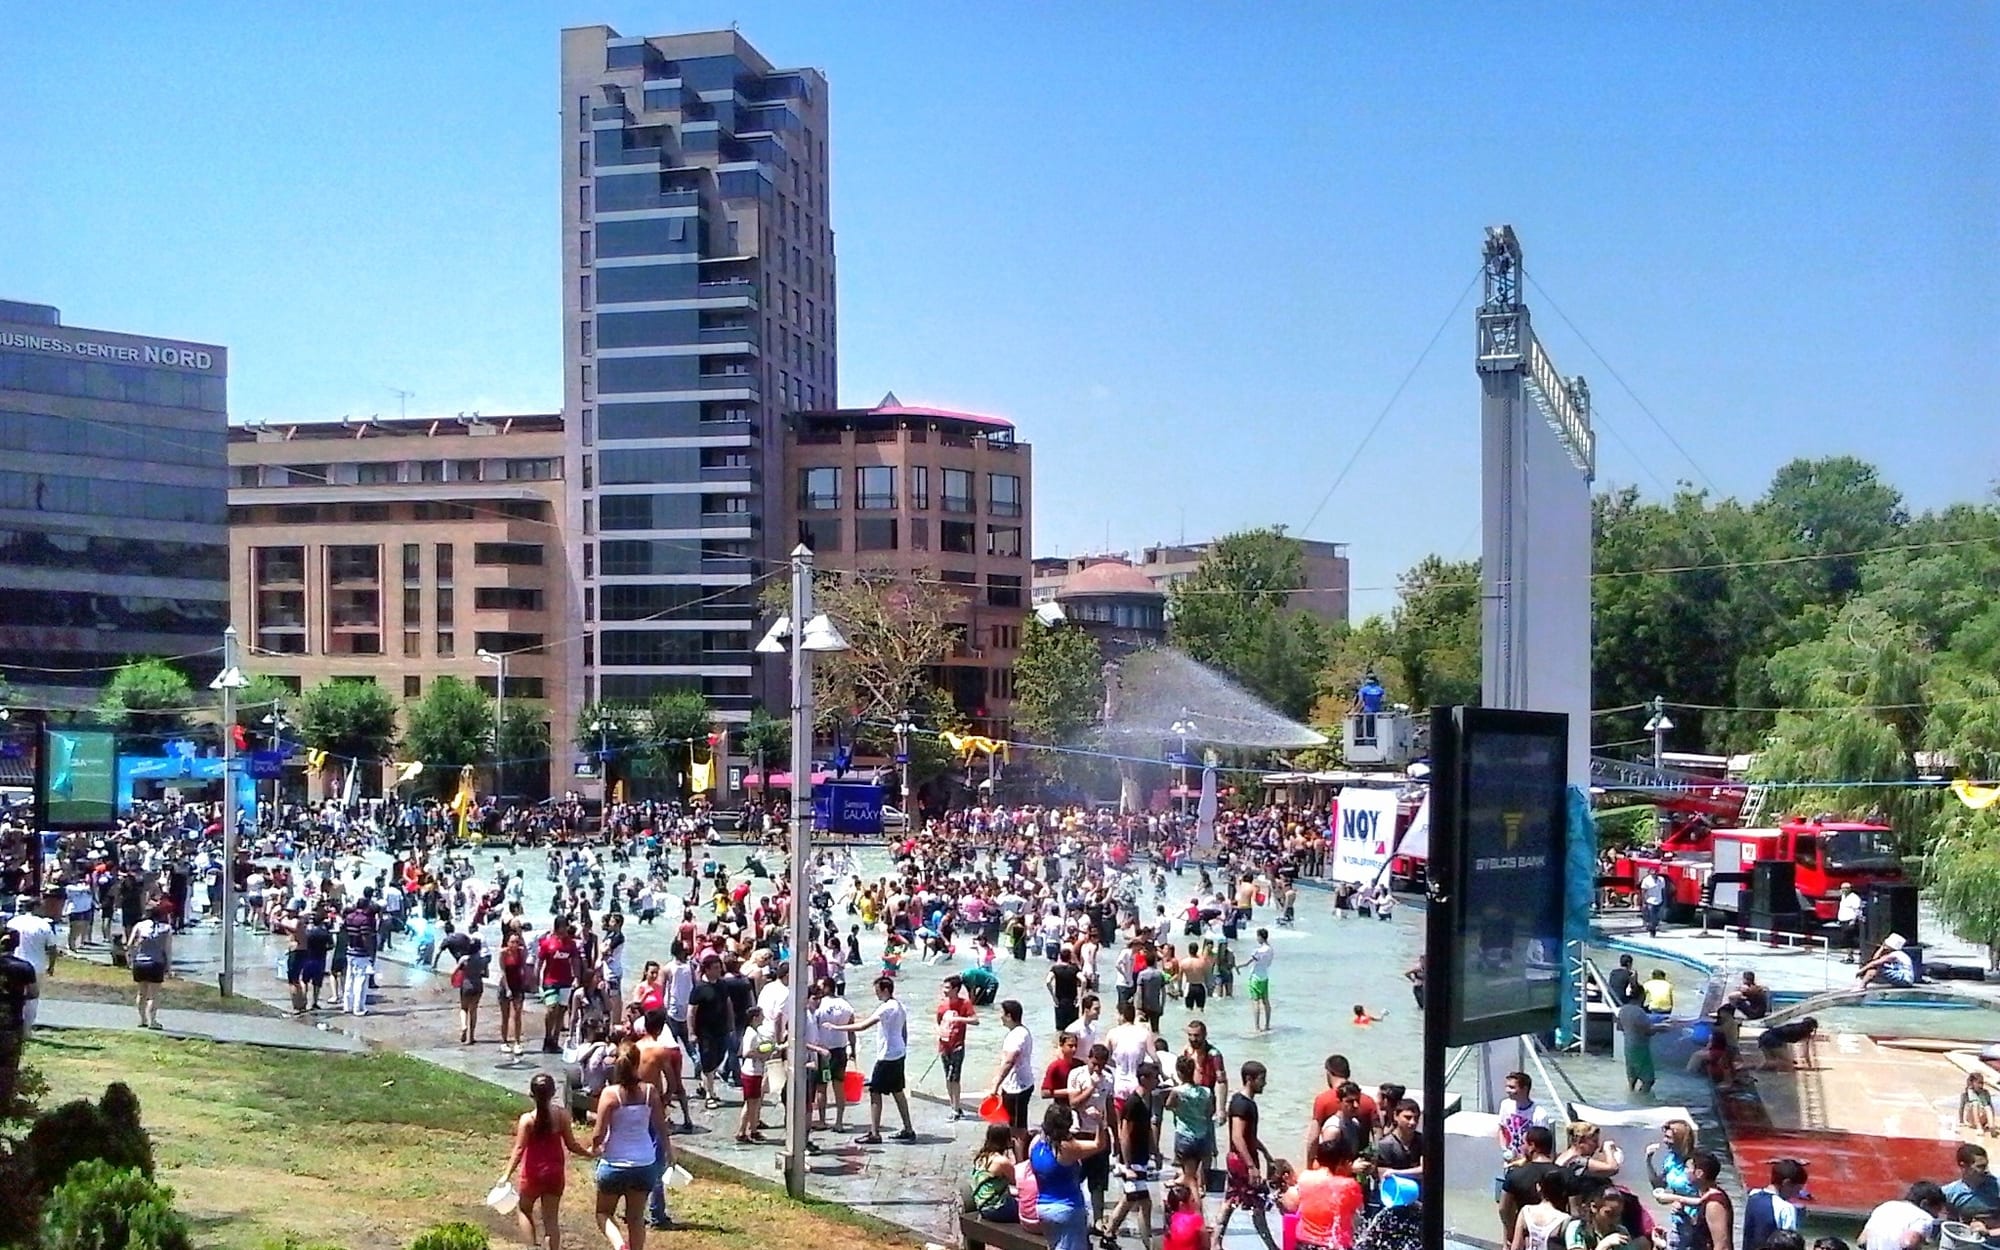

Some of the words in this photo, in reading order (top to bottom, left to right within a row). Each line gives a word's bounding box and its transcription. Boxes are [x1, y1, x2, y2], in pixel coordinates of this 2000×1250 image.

[0, 332, 72, 353] USINESS
[75, 341, 140, 362] CENTER
[144, 345, 213, 370] NORD
[844, 809, 880, 821] GALAXY
[1342, 808, 1381, 841] NOY
[1476, 856, 1517, 870] BYBLOS
[1518, 855, 1546, 868] BANK
